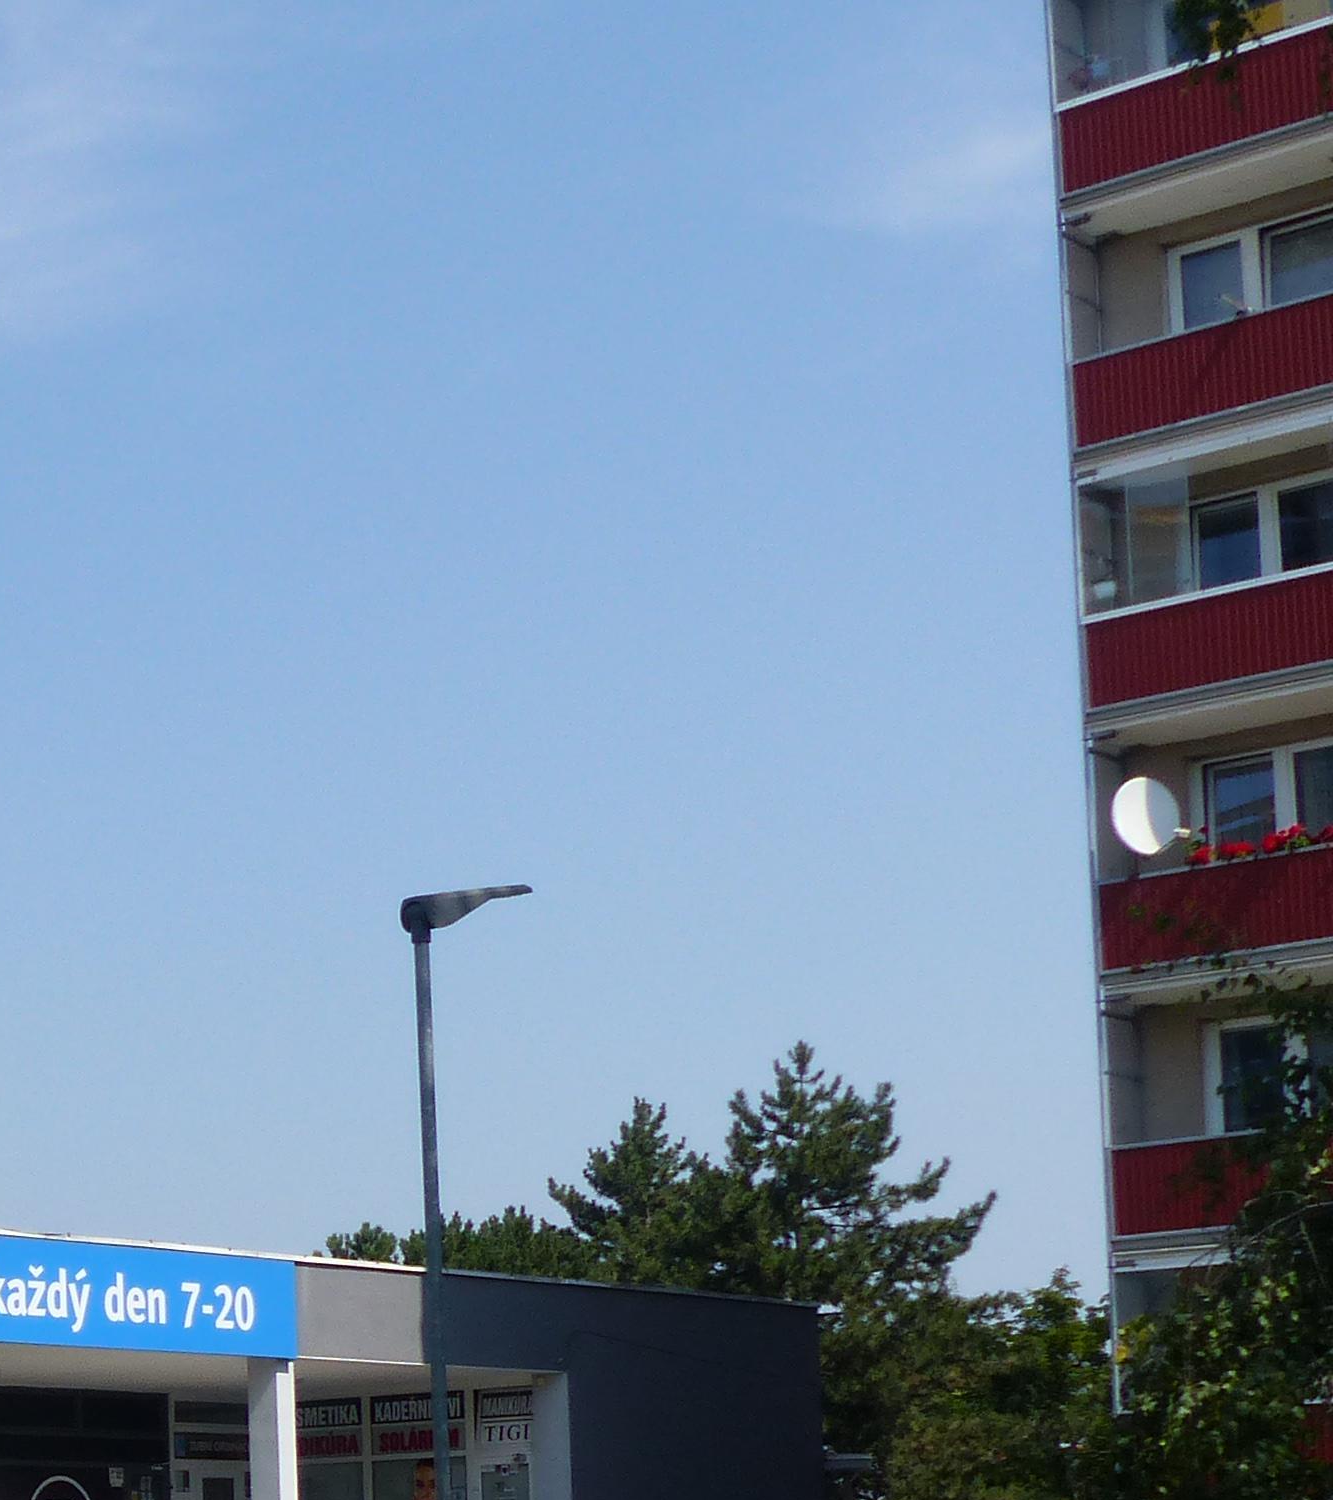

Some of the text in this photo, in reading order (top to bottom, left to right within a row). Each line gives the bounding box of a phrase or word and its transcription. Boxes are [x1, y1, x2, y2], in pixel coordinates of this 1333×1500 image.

[104, 1271, 167, 1325] den
[181, 1282, 255, 1331] 7-20
[296, 1404, 359, 1427] SMETIKA
[374, 1393, 461, 1421] KADEŘNIVÍ
[298, 1423, 528, 1457] DIKÚRA SOLÁRIM TIGI
